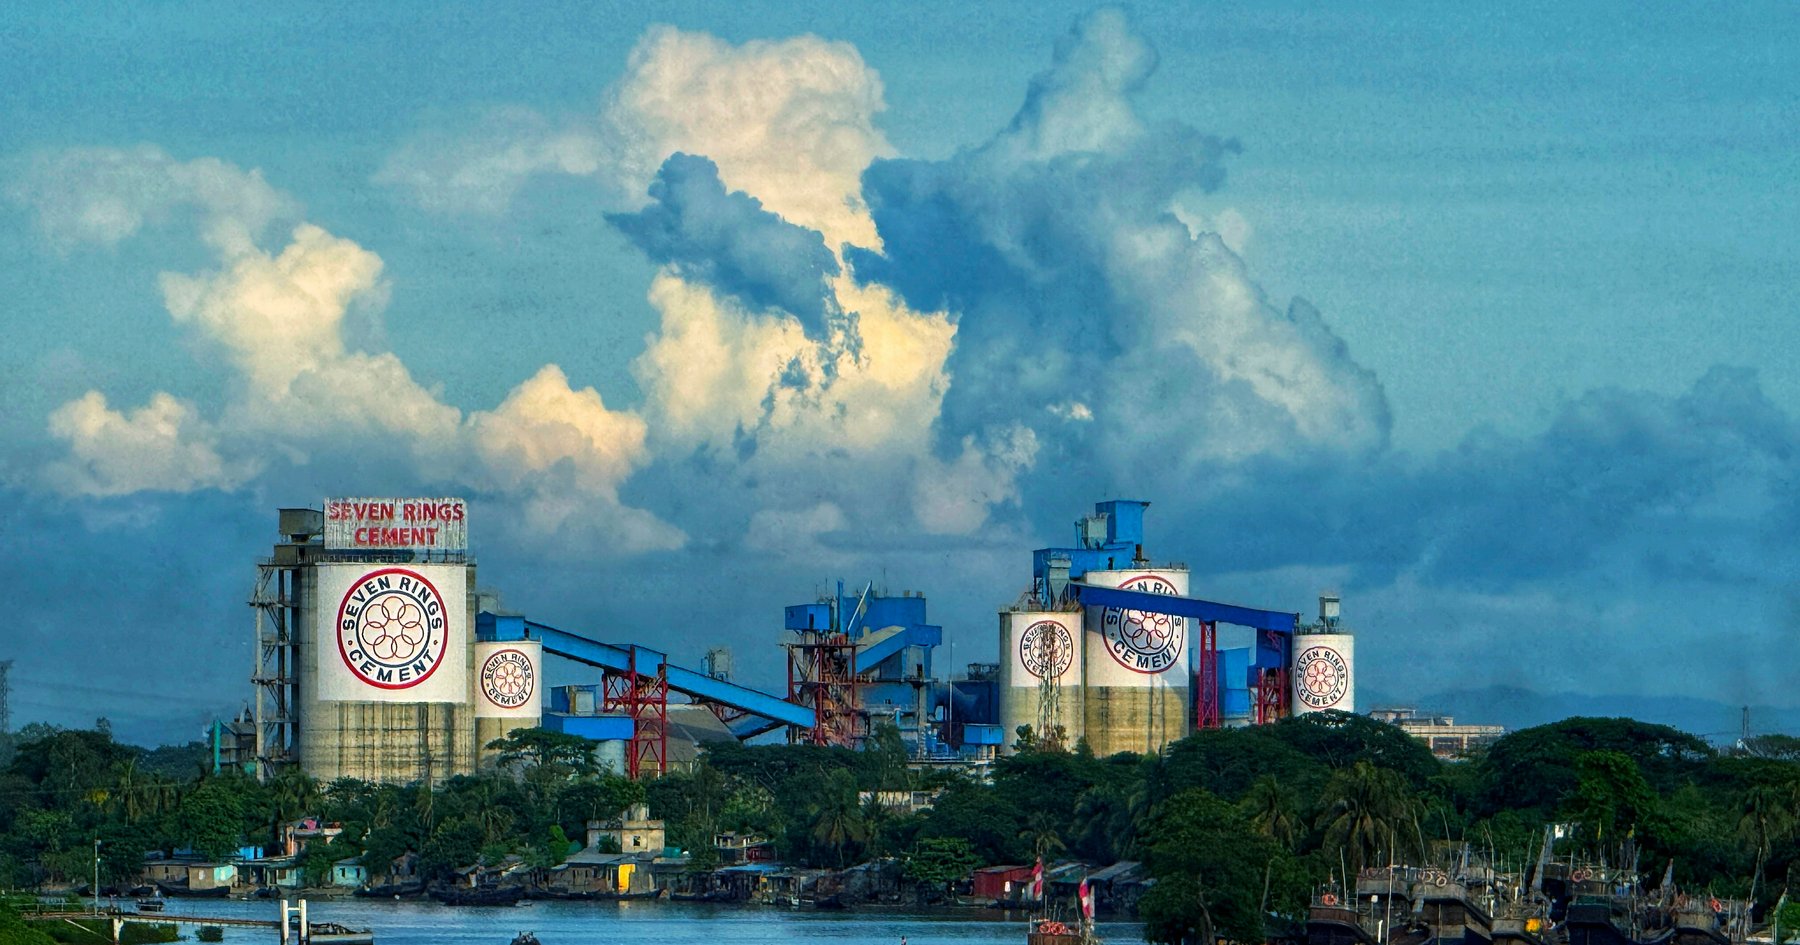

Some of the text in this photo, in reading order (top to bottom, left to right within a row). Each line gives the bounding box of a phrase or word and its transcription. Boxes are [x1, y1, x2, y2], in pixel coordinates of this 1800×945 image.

[329, 502, 464, 521] SEVEN RINGS
[355, 527, 438, 546] CEMENT
[343, 576, 442, 631] SEVEN RINGS
[1113, 640, 1177, 668] CEMENT
[349, 649, 435, 682] CEMENT
[485, 654, 508, 680] SEVEN
[489, 688, 528, 705] CEMENT
[1300, 687, 1341, 706] CEMENT
